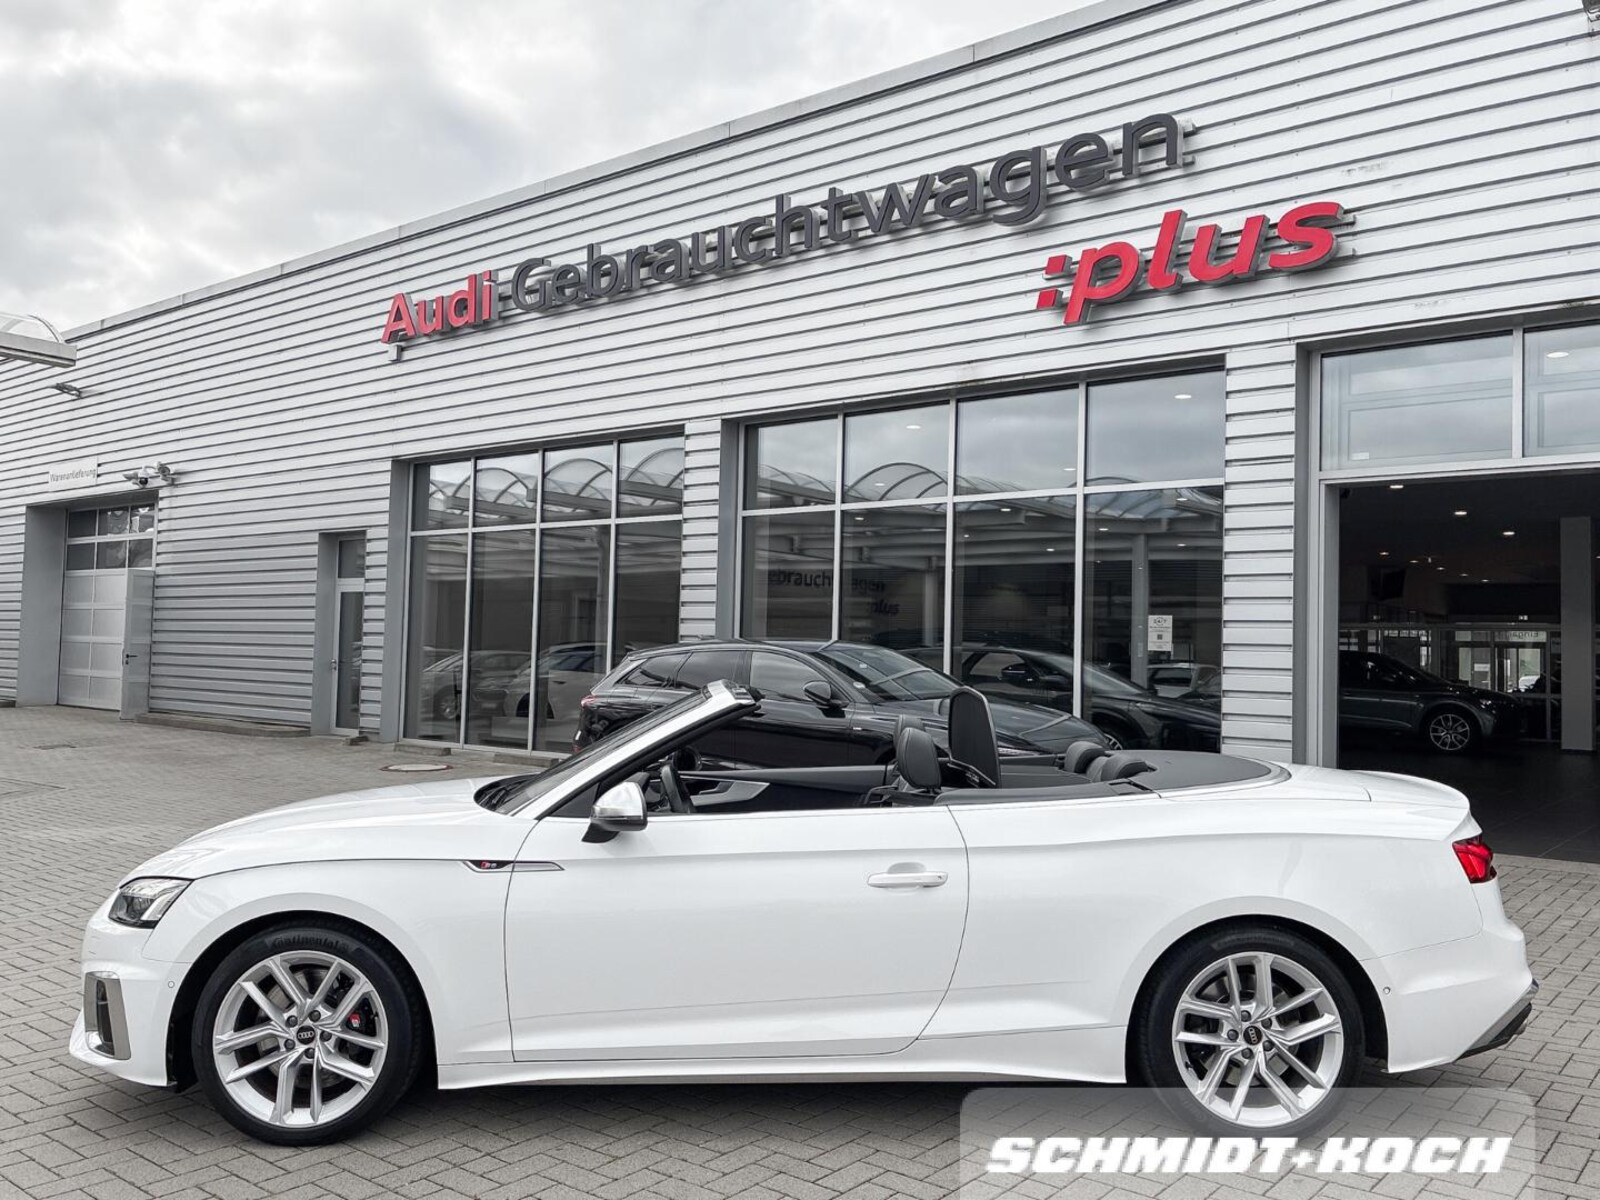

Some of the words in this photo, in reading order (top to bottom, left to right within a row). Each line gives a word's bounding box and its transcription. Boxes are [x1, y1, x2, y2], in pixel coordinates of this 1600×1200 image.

[381, 270, 493, 344] Audi
[511, 113, 1184, 312] Gebrauchtwagen
[50, 469, 97, 482] Warenanlieferung
